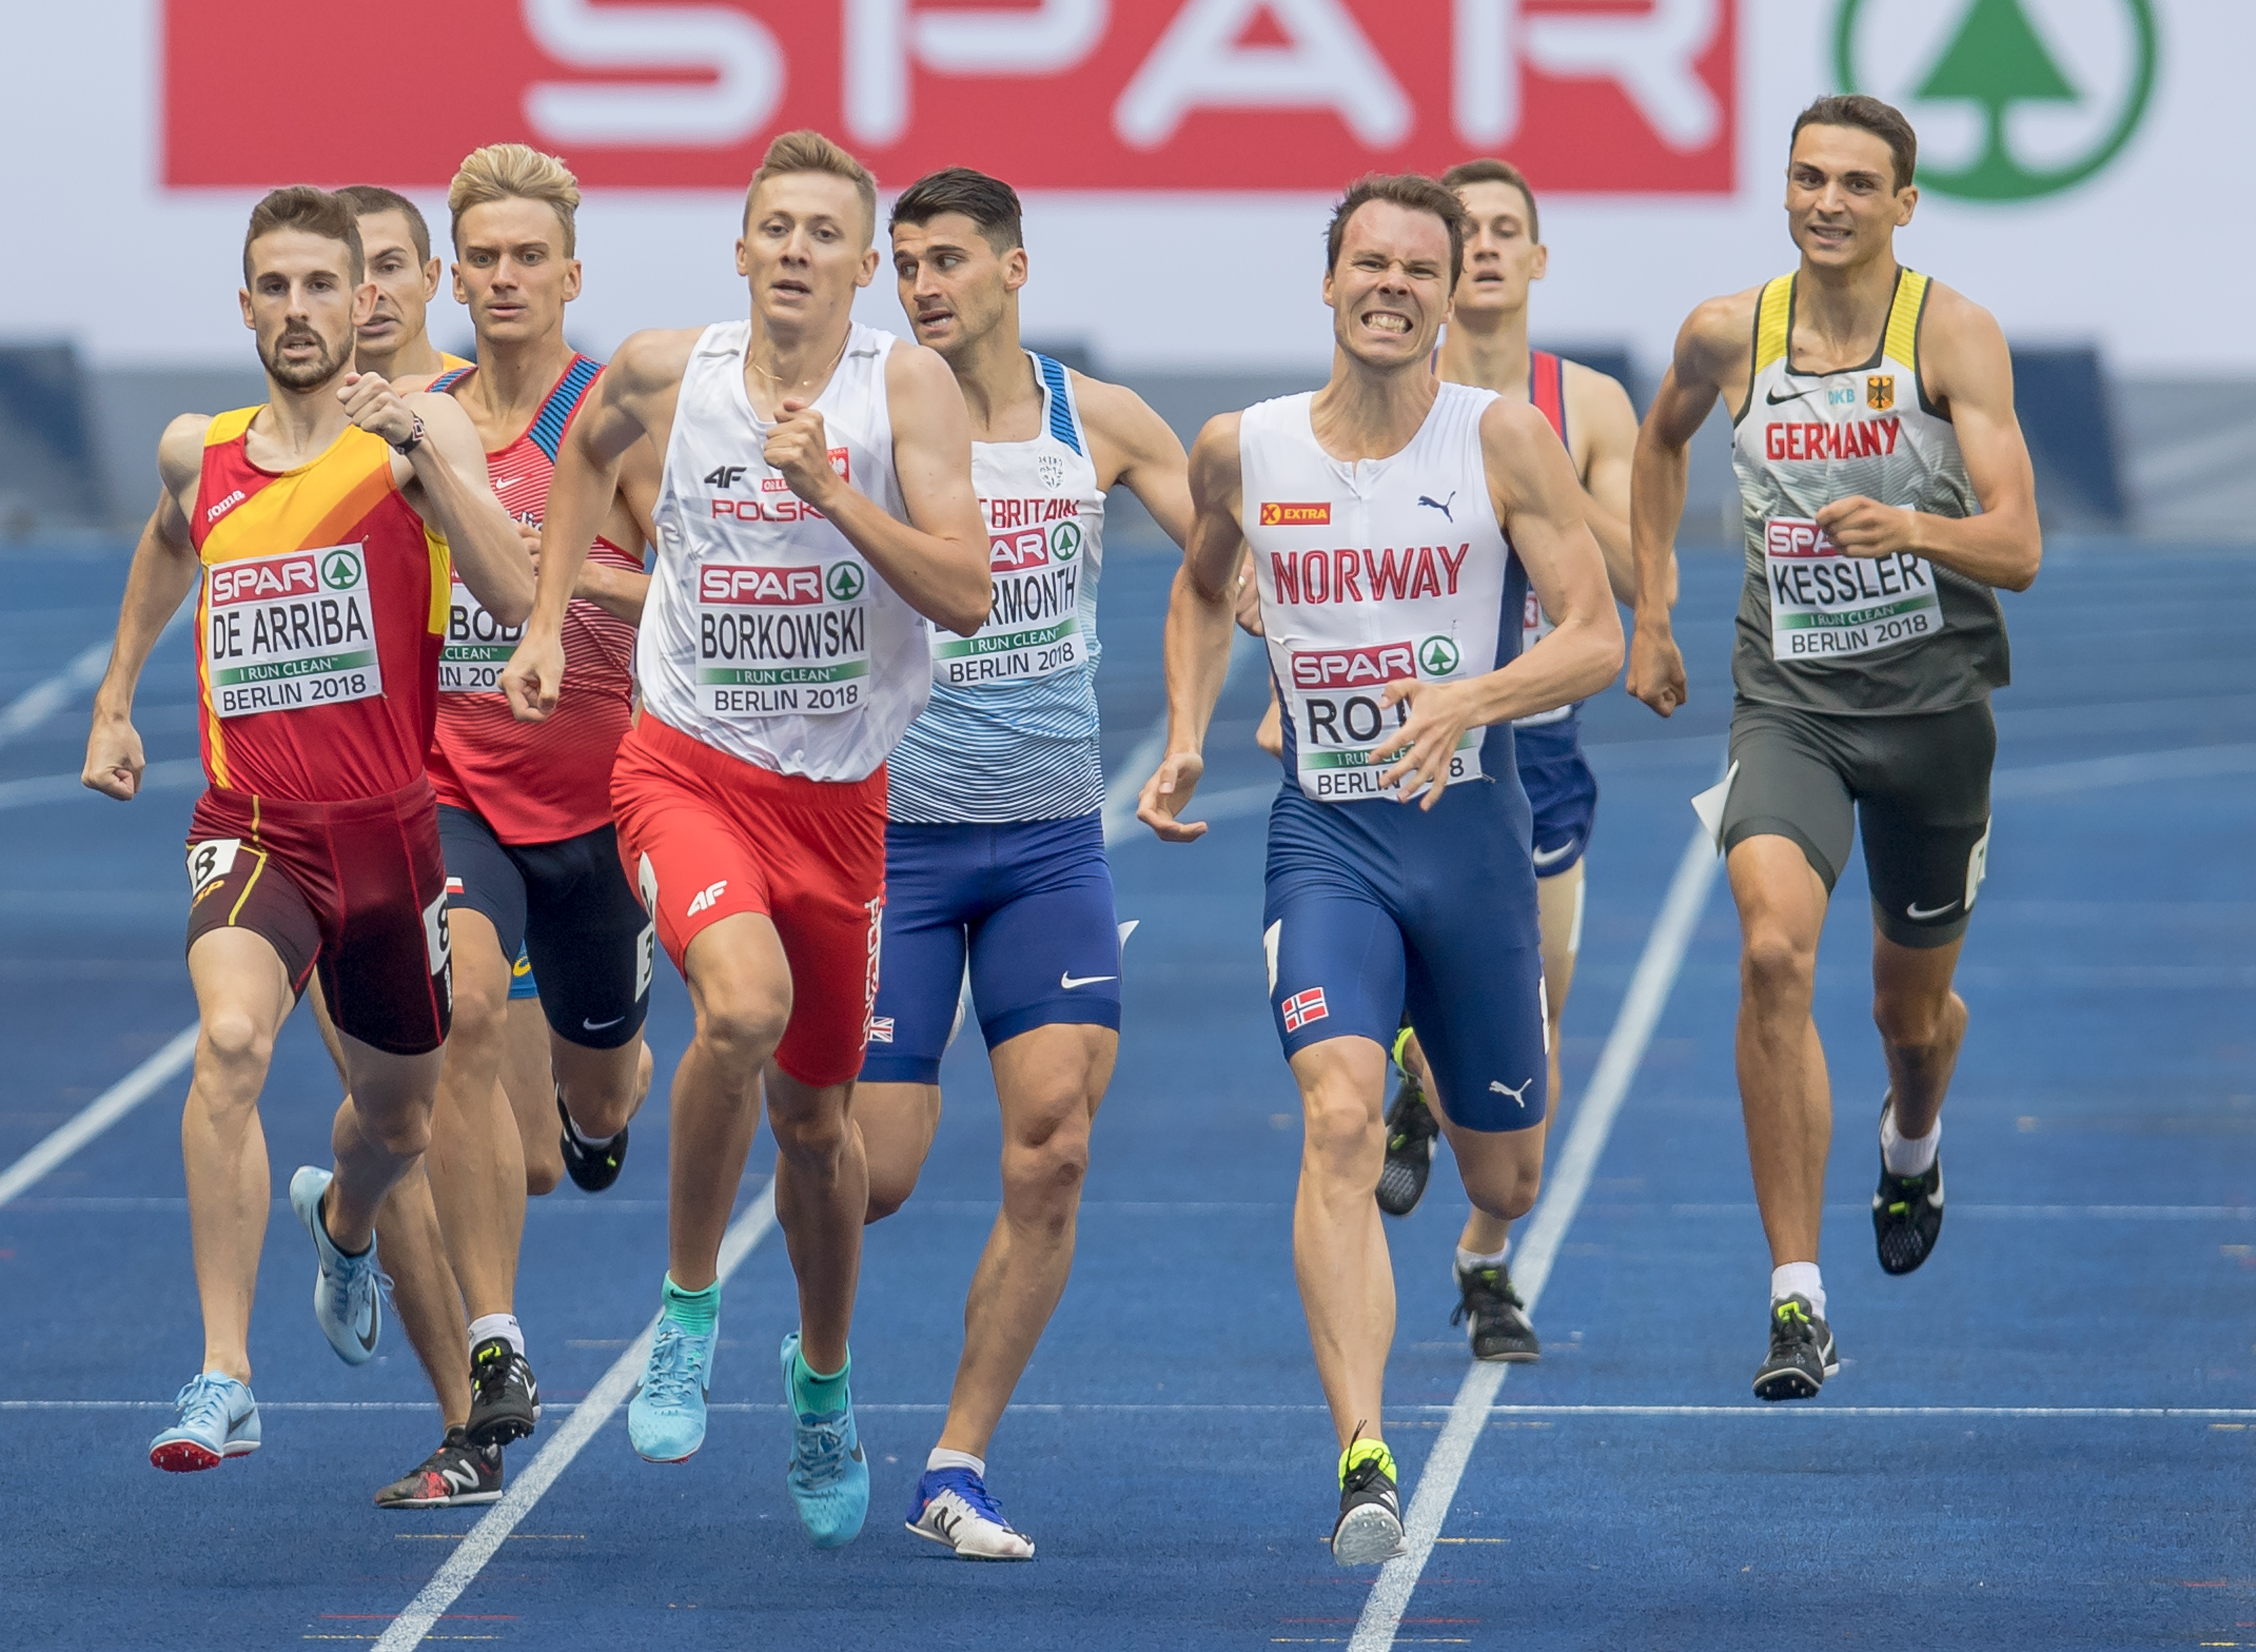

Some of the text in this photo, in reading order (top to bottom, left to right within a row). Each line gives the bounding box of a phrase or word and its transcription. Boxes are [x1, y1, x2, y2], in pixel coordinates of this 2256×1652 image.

[522, 0, 1722, 150] SPAR
[1765, 416, 1900, 461] GERMANY
[711, 499, 825, 522] POLSK
[991, 498, 1081, 528] BRITAIN
[1284, 508, 1328, 519] EXTRA
[990, 533, 1046, 565] AR
[1769, 525, 1834, 554] SPA
[214, 560, 315, 602] SPAR
[702, 569, 820, 601] SPAR
[1270, 543, 1470, 605] NORWAY
[1772, 552, 1927, 605] KESSLER
[976, 566, 1077, 628] RMONTH
[214, 596, 368, 660] DE ARRIBA
[700, 606, 866, 660] BORKOWSKI
[1792, 614, 1928, 654] BERLIN 2018
[1810, 616, 1816, 626] I
[1818, 613, 1846, 626] RUN
[949, 642, 1075, 683] BERLIN 2018
[969, 641, 975, 653] I
[977, 637, 1010, 653] RUN
[240, 669, 245, 681] I
[247, 666, 279, 680] RUN
[736, 670, 741, 682] I
[744, 669, 777, 683] RUN
[1294, 647, 1414, 685] SPAR
[223, 673, 367, 712] BERLIN 2018
[714, 684, 859, 712] BERLIN 2018
[1337, 754, 1343, 765] I
